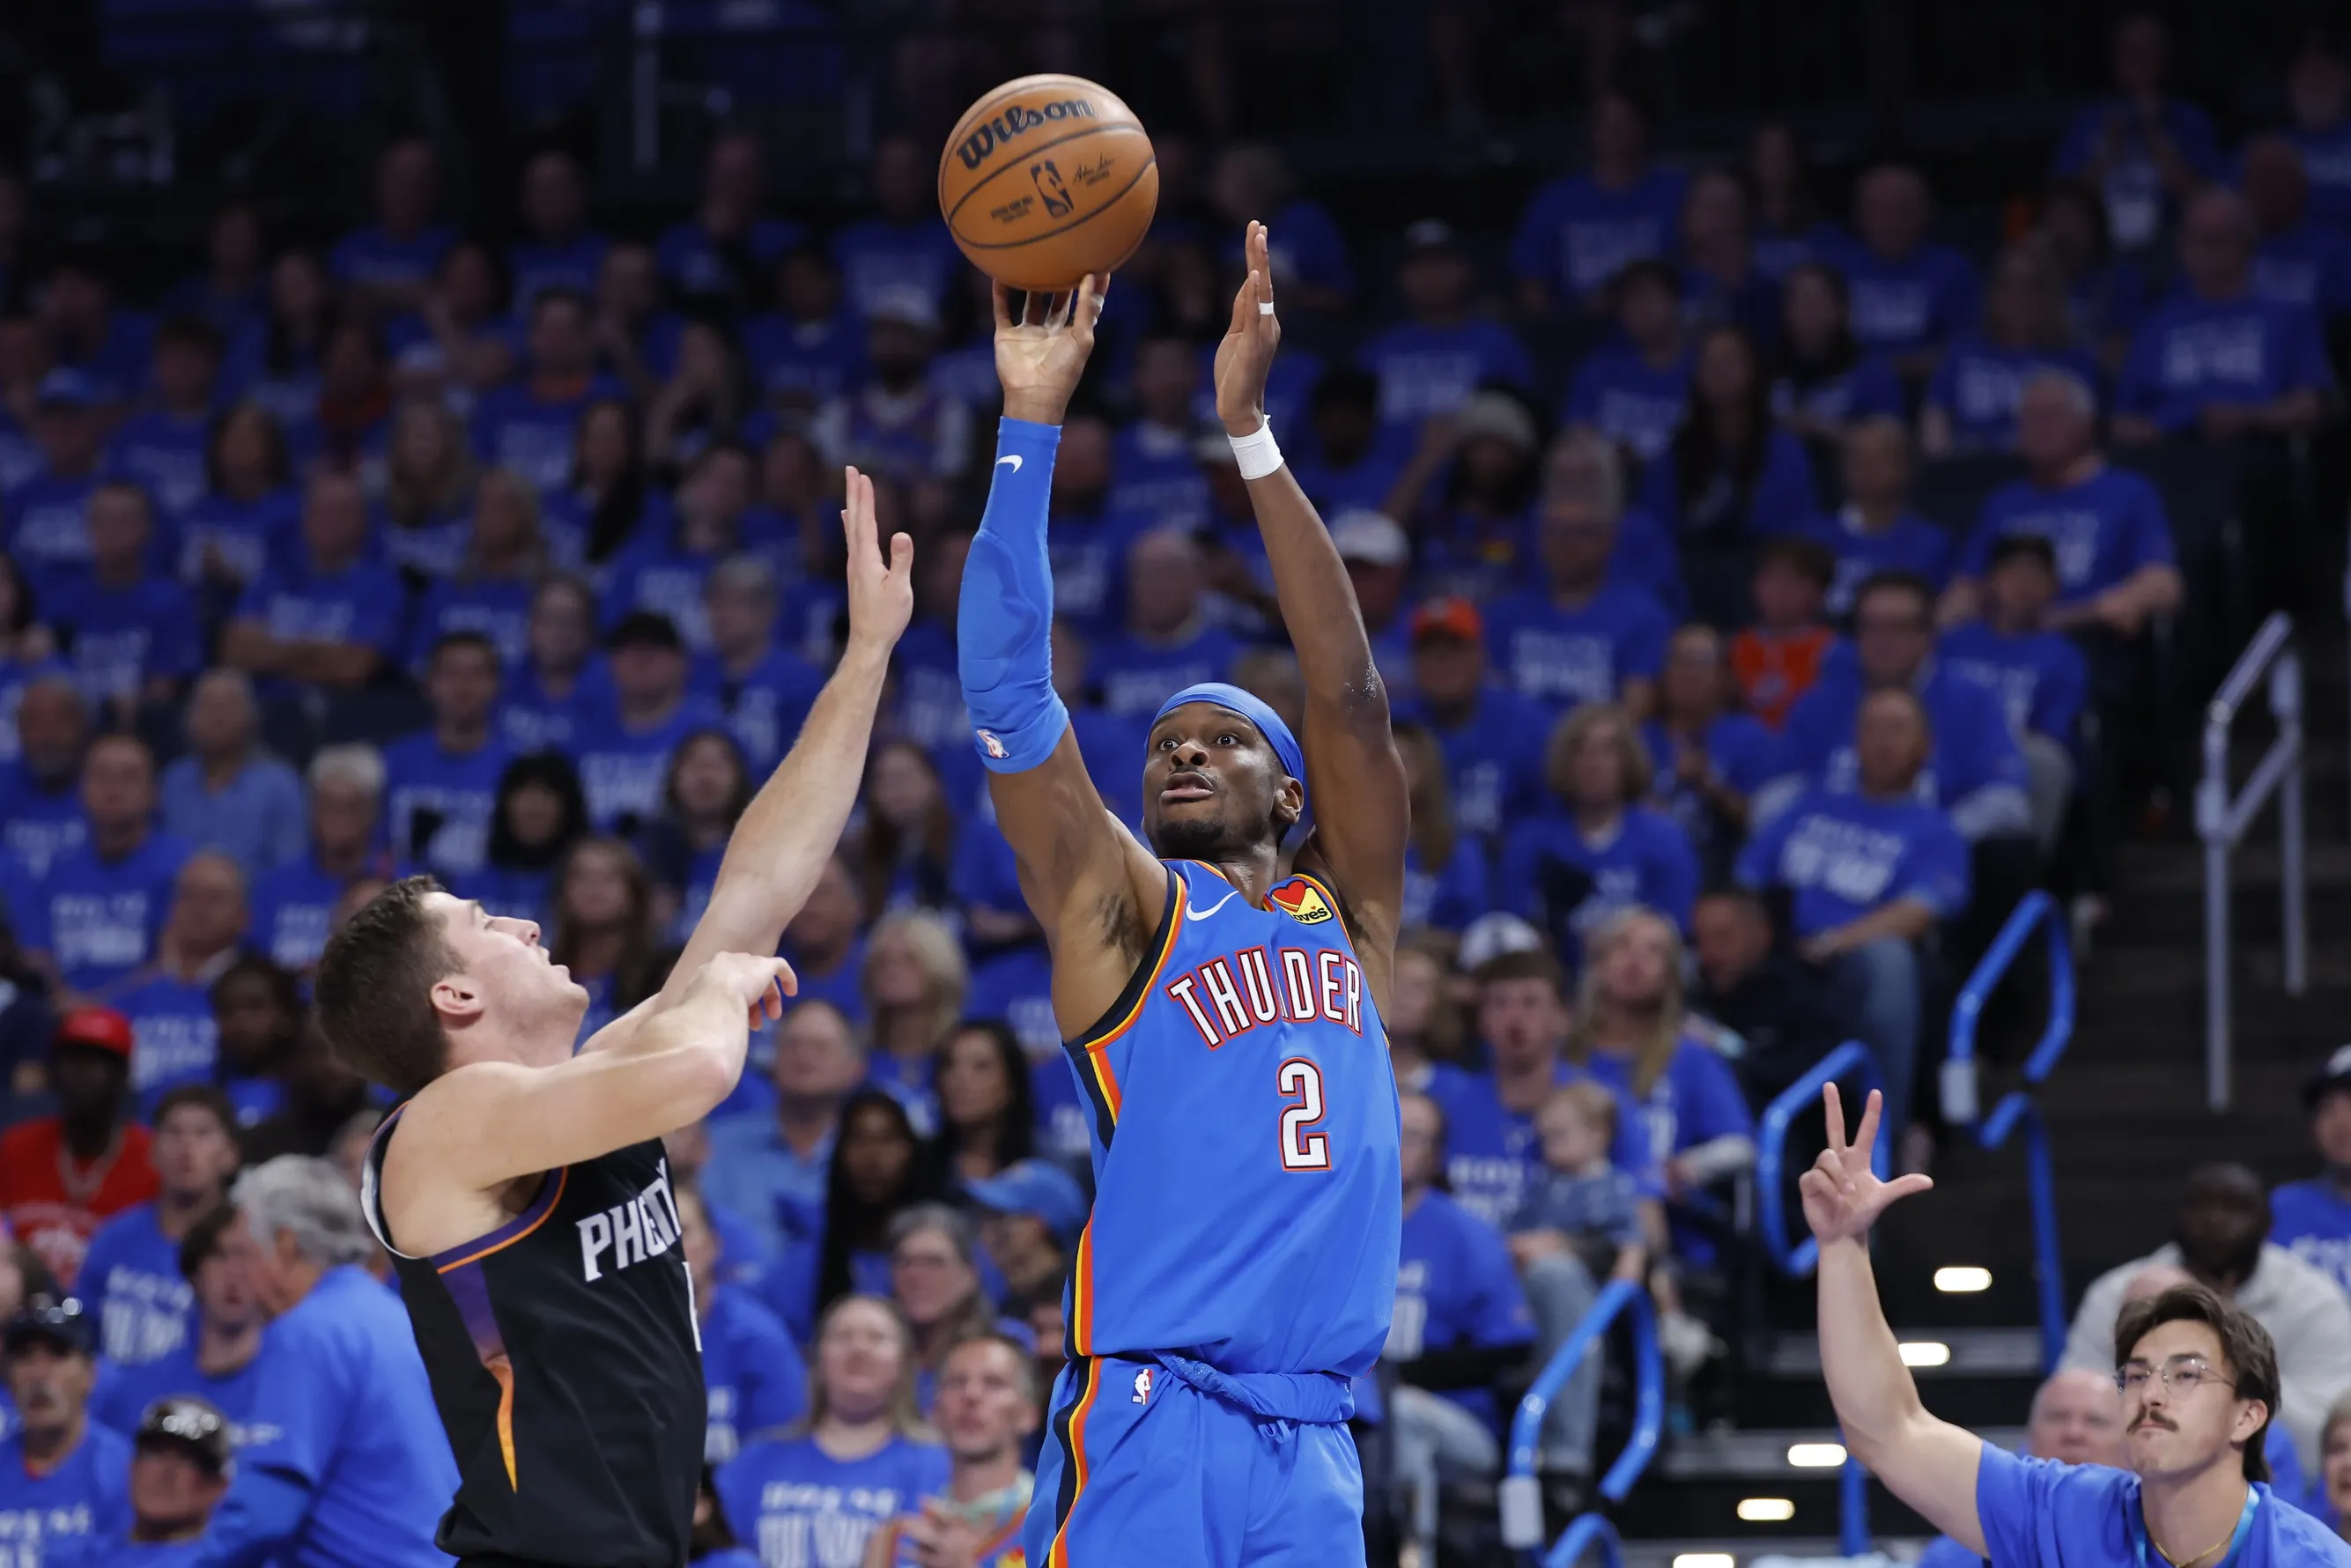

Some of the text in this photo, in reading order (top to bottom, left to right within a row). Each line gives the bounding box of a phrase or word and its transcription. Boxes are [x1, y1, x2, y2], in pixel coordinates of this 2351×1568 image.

[957, 99, 1099, 170] Wilson
[1293, 907, 1328, 921] oves
[1166, 946, 1363, 1050] THUDER
[1277, 1057, 1332, 1172] 2
